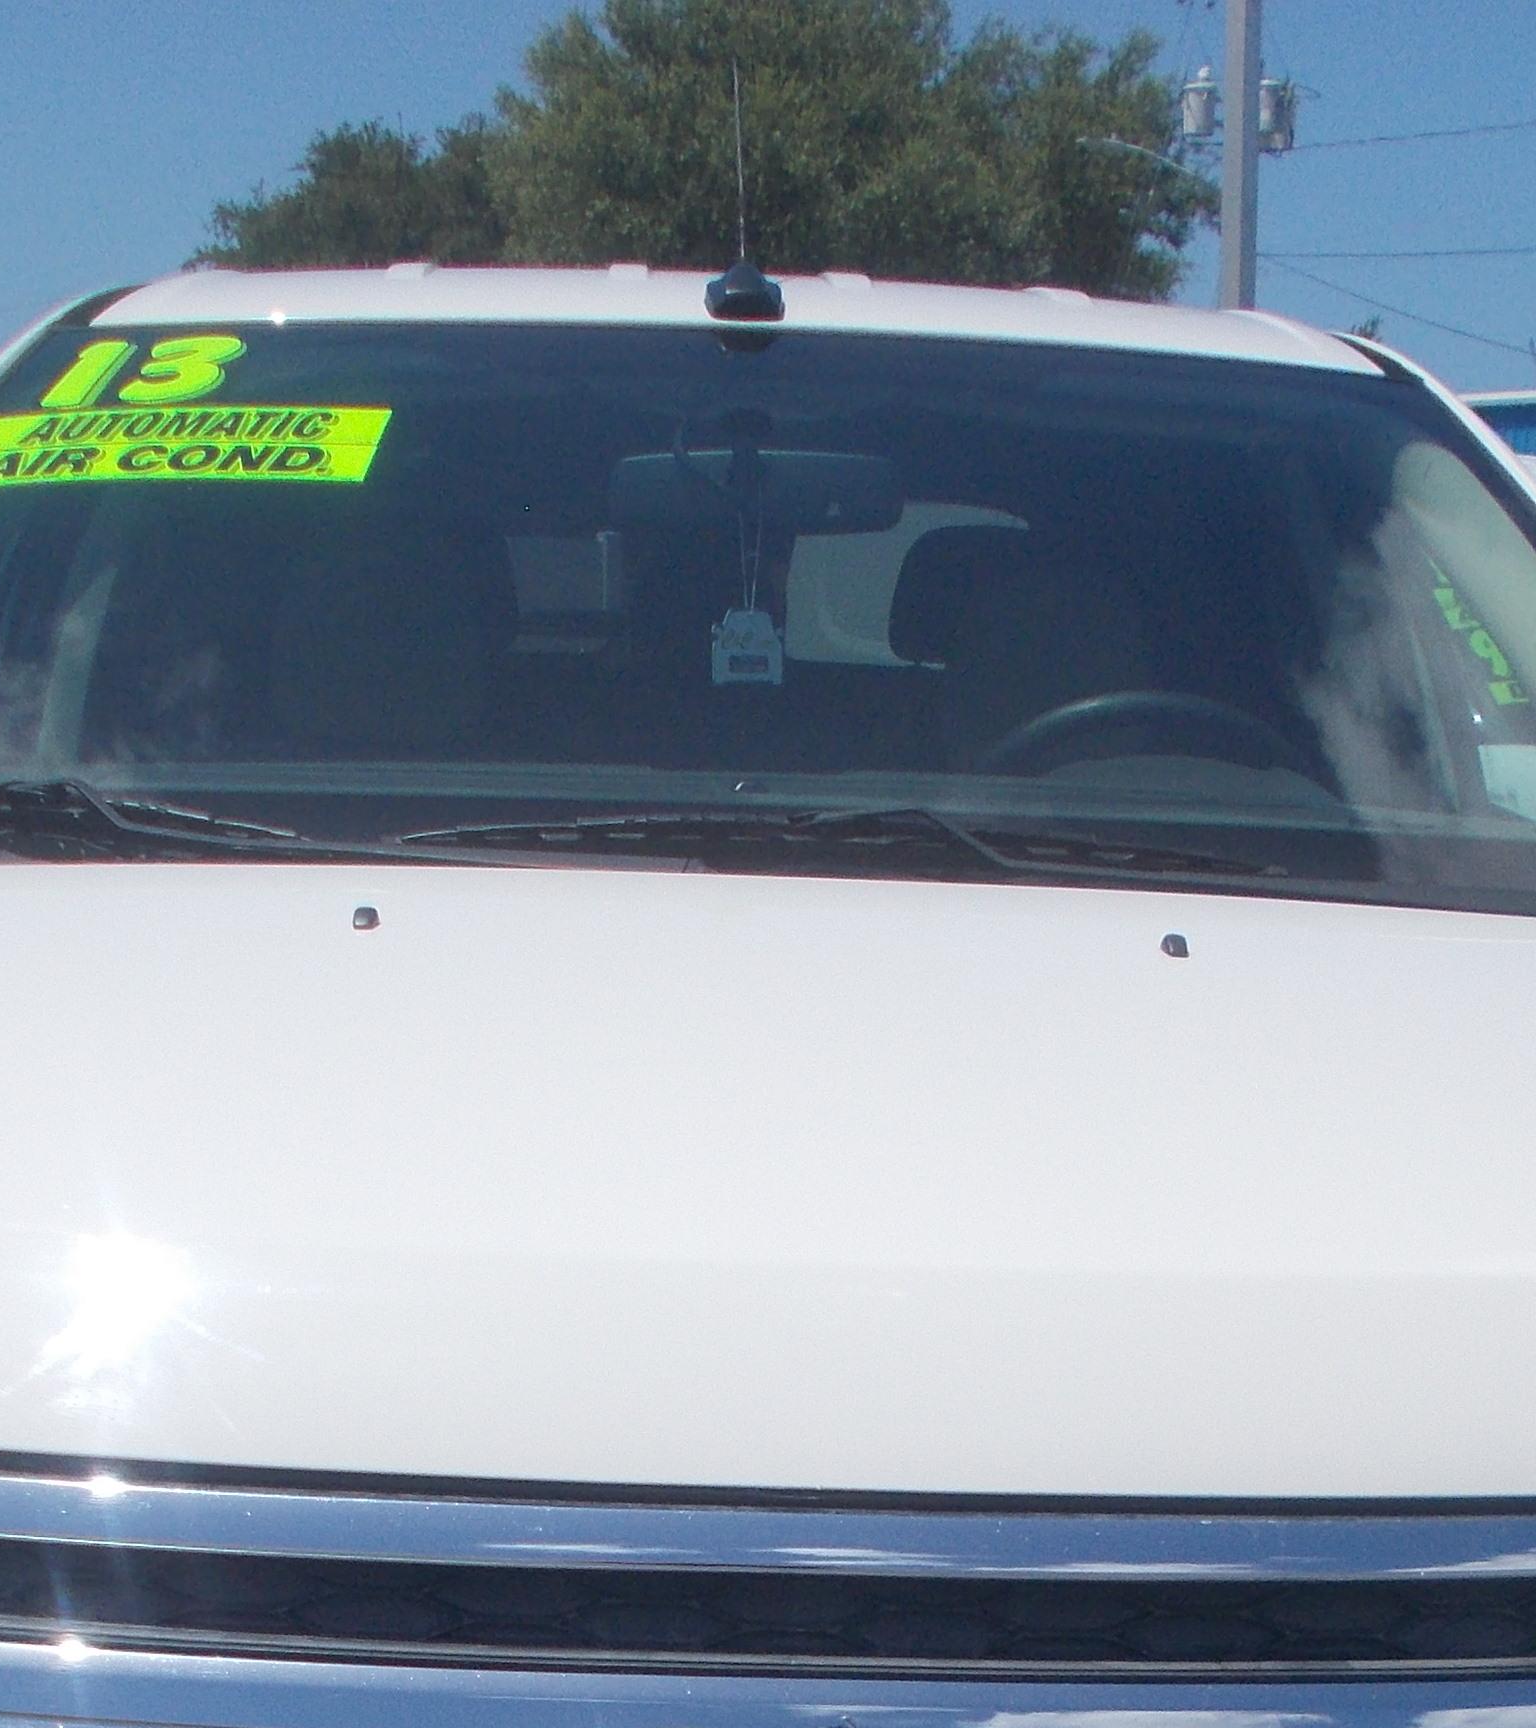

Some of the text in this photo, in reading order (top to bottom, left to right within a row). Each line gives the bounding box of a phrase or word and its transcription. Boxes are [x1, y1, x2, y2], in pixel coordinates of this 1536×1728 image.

[41, 335, 246, 409] 13
[18, 412, 339, 446] AUTOMATIC
[117, 445, 335, 476] COND.
